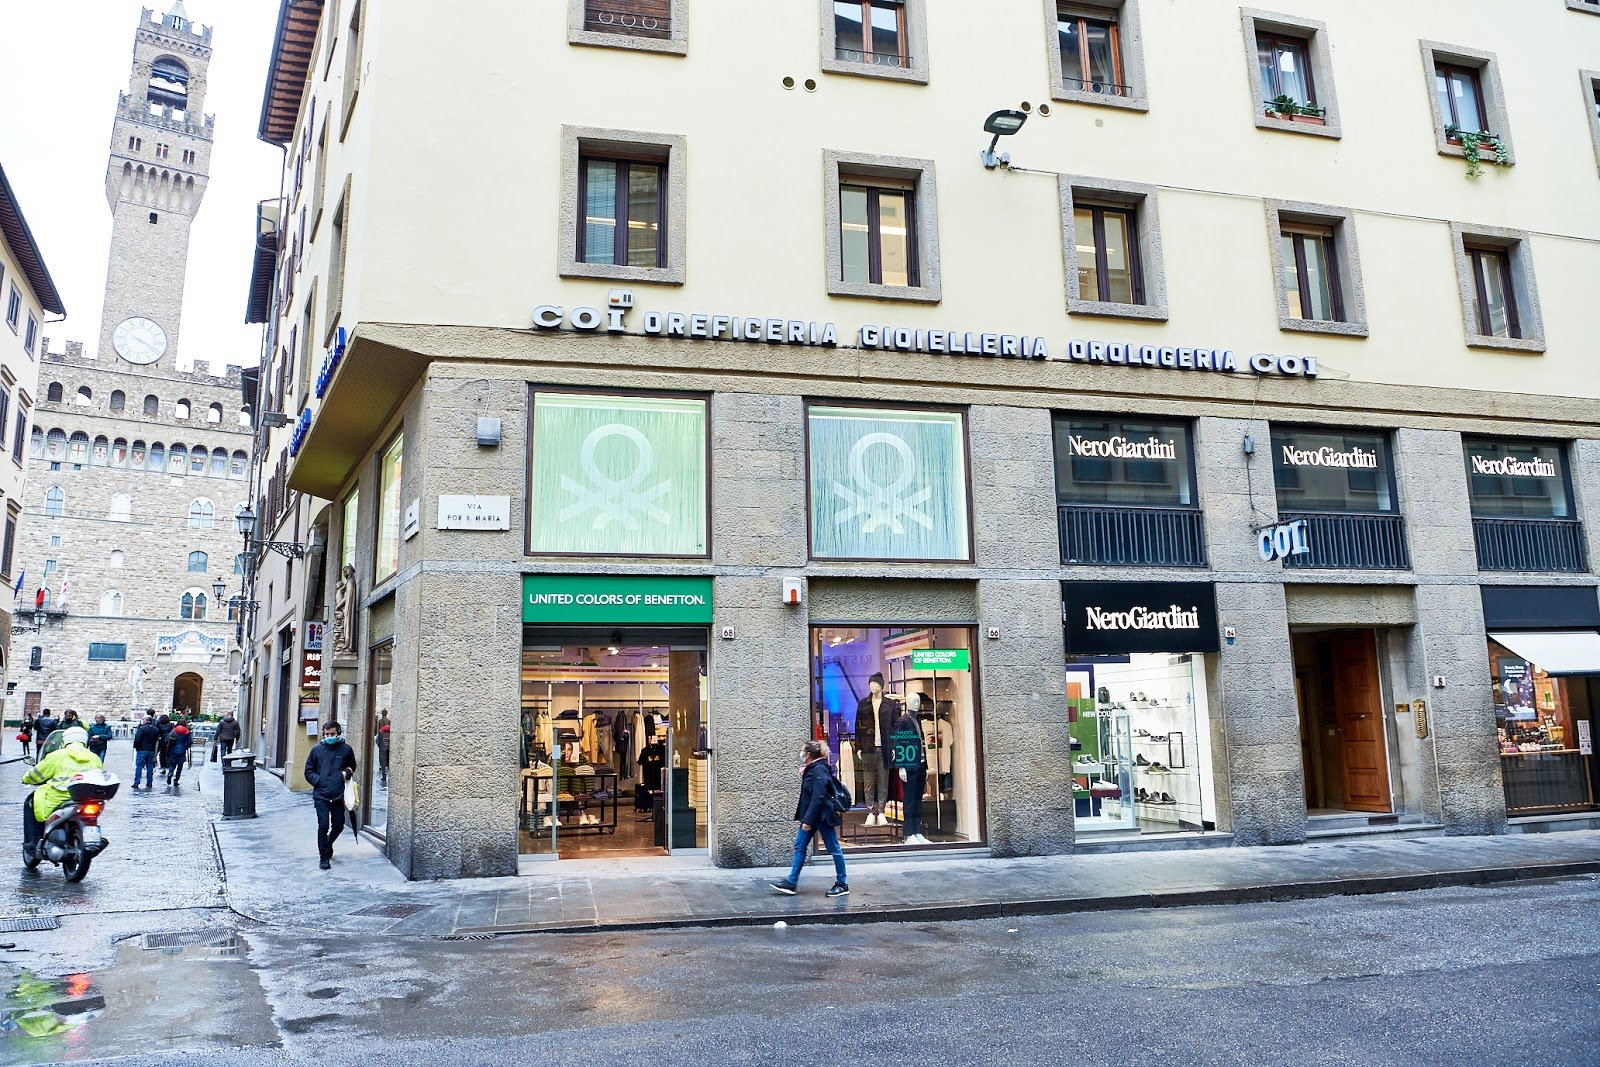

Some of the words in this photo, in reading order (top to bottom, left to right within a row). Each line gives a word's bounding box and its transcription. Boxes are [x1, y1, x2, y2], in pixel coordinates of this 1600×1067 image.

[532, 305, 625, 332] COI
[644, 311, 838, 345] OREFICERIA
[860, 325, 1047, 358] GIOIELLERIA
[1069, 340, 1237, 371] OROLOGERIA
[1250, 354, 1318, 377] COI
[1067, 435, 1176, 459] NeroGiardini
[1282, 445, 1378, 468] NeroGiardini
[1471, 455, 1556, 477] NeroGiardini
[1258, 520, 1309, 561] COI
[529, 593, 574, 605] UNITED
[575, 594, 623, 605] COLORS
[625, 594, 642, 605] OF
[644, 594, 706, 606] BENETTON.
[1085, 604, 1200, 630] NeroGiardini
[723, 629, 734, 637] 68
[990, 629, 999, 637] 66
